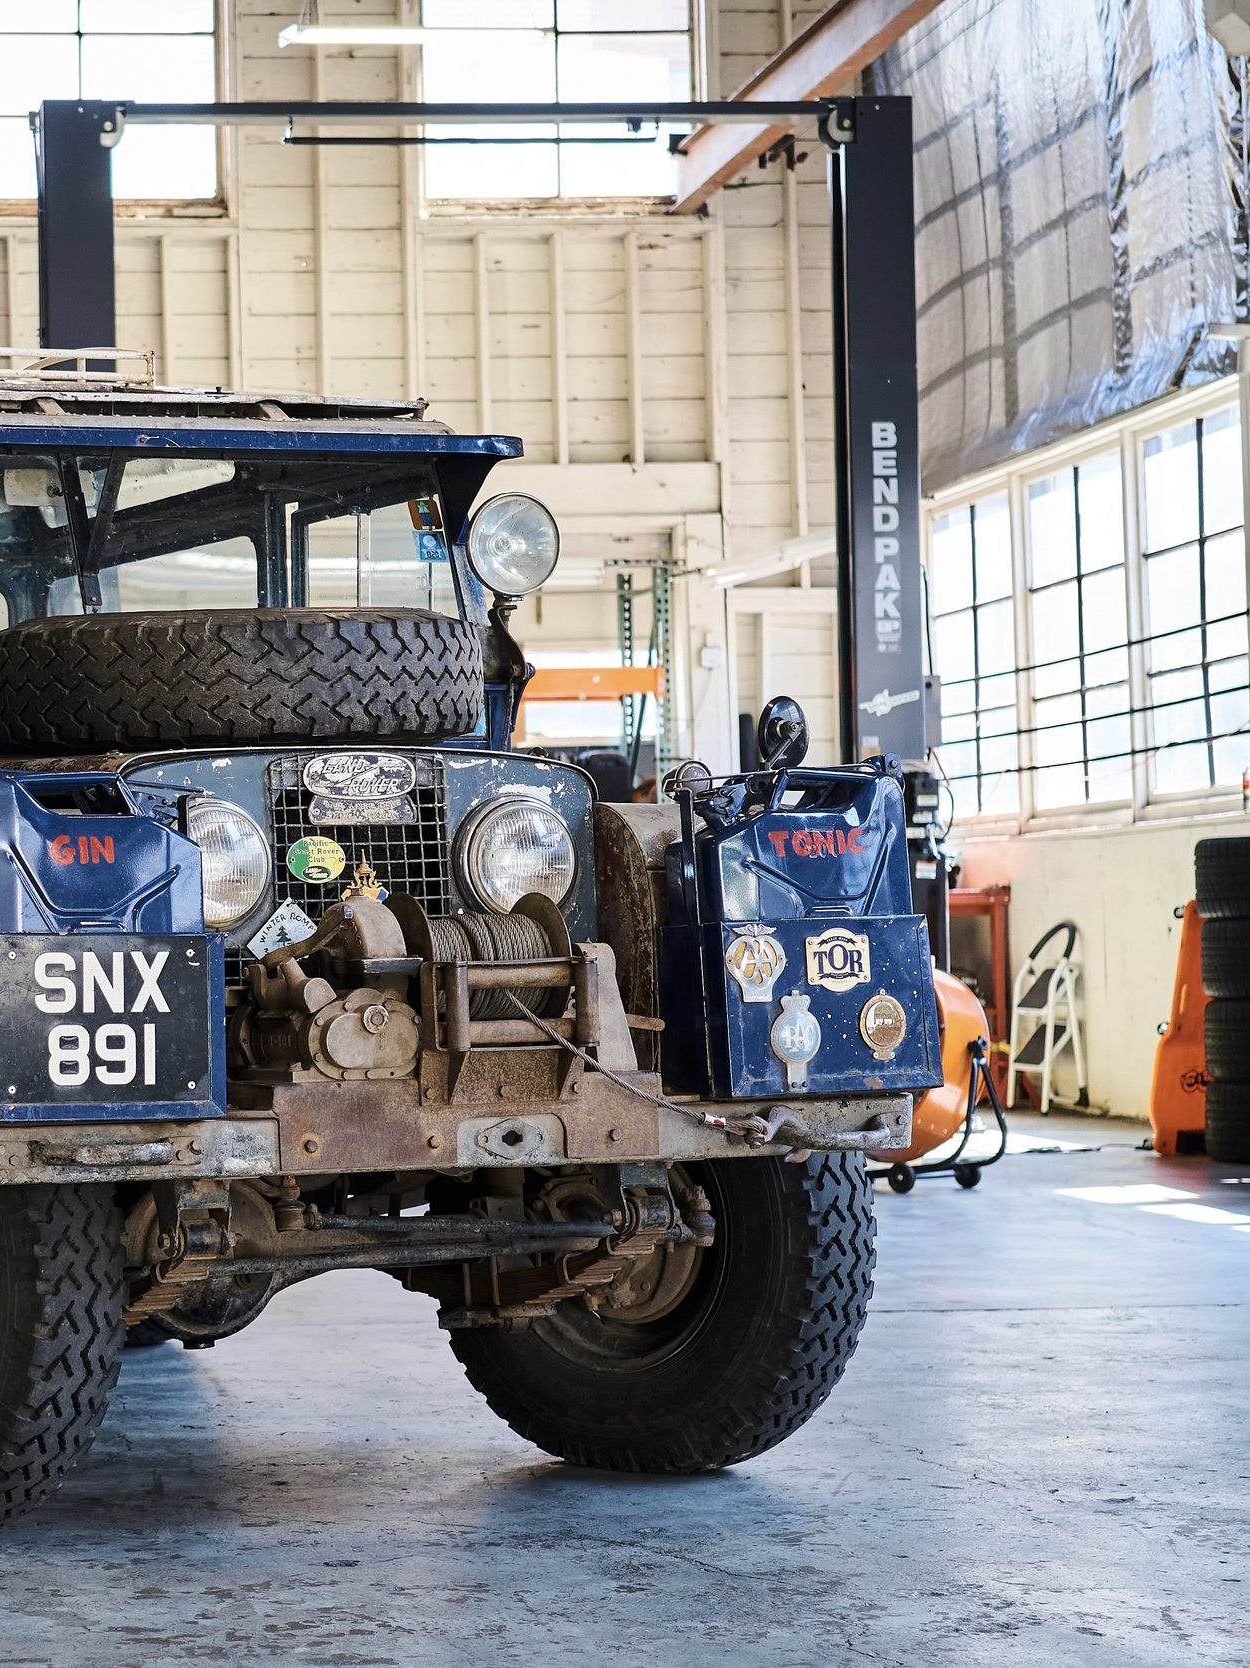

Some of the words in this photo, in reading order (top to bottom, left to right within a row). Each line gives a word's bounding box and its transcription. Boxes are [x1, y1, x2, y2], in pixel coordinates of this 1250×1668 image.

[871, 421, 901, 618] BENDPAK
[322, 758, 366, 775] LAND
[347, 778, 402, 794] ROVER
[49, 834, 115, 865] GIN
[768, 827, 863, 858] TONIC
[259, 913, 287, 944] WINTER
[289, 912, 314, 931] ROMP
[813, 944, 864, 975] TOR
[34, 951, 171, 1013] SNX
[781, 1018, 814, 1052] RAC
[48, 1023, 156, 1086] 891
